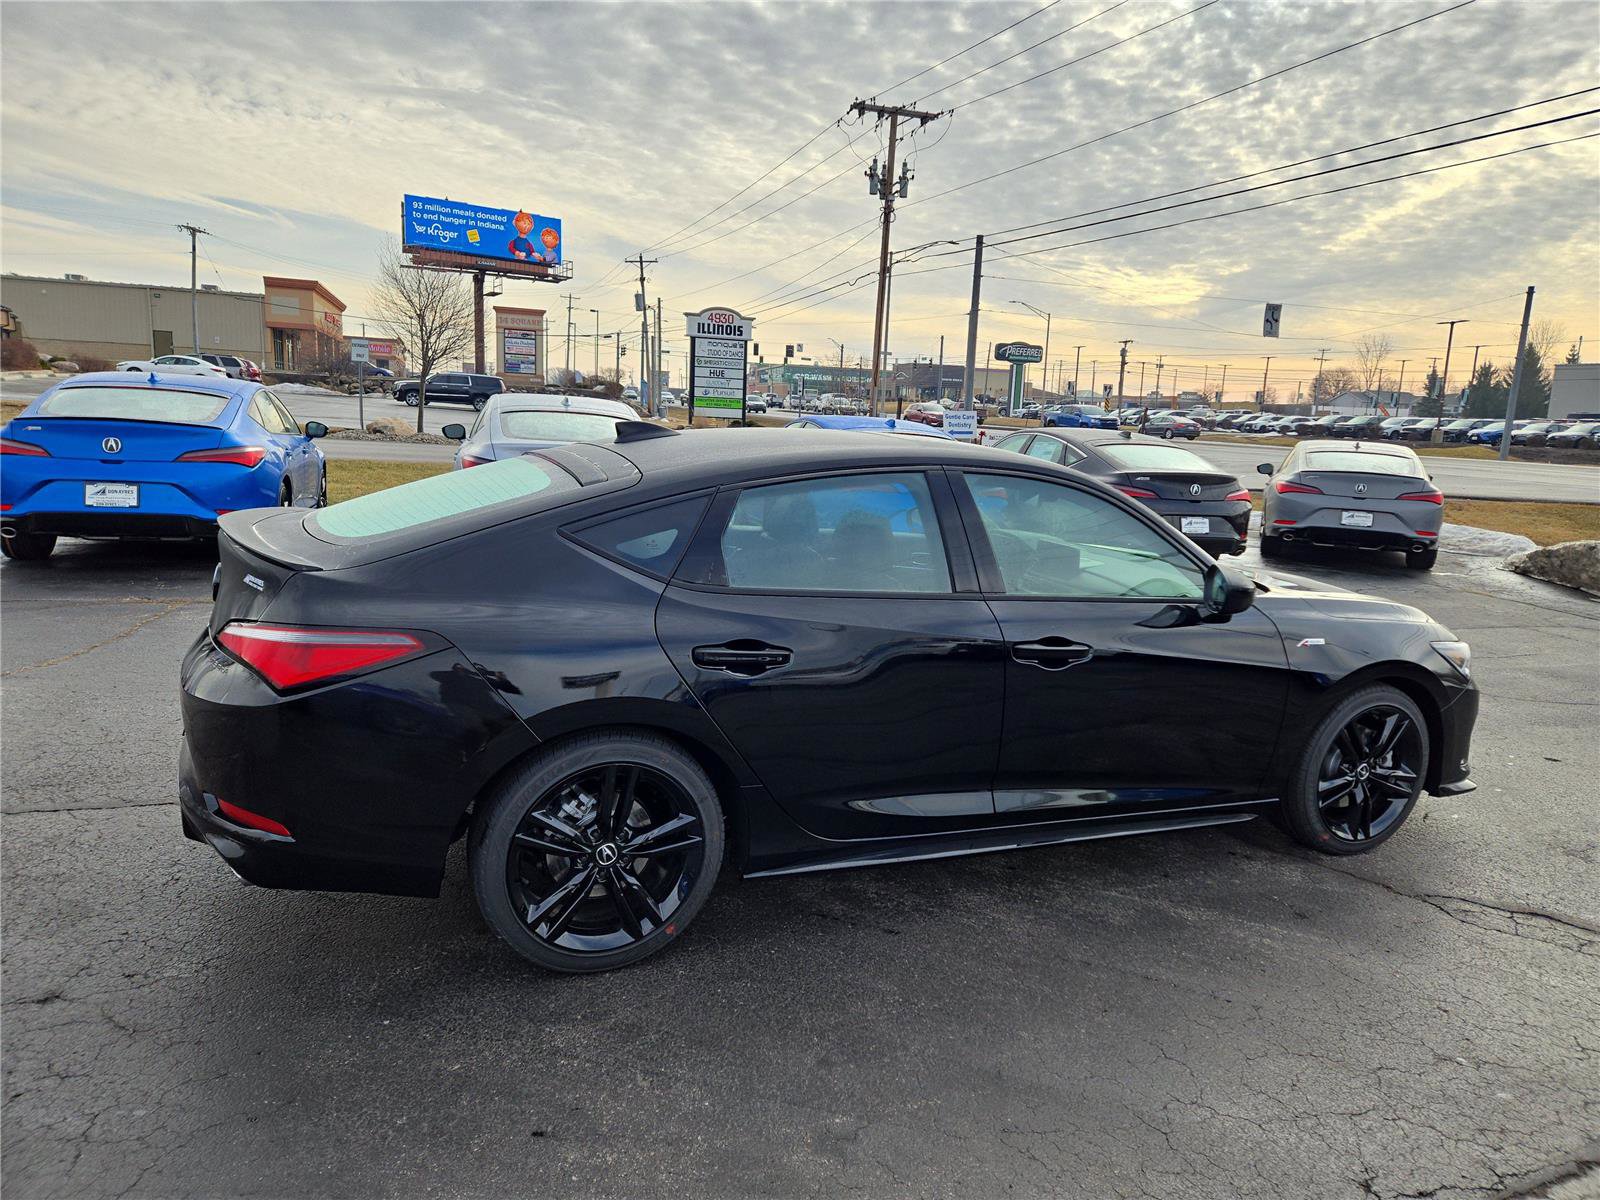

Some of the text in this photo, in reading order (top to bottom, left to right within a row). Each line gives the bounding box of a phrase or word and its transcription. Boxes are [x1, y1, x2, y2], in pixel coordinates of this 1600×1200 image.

[423, 212, 438, 220] end
[440, 215, 466, 226] hunger
[424, 204, 451, 213] million
[452, 208, 475, 217] meals
[476, 212, 507, 222] donated
[428, 223, 458, 242] Kroger
[708, 312, 734, 324] 4930
[709, 370, 726, 378] HUE
